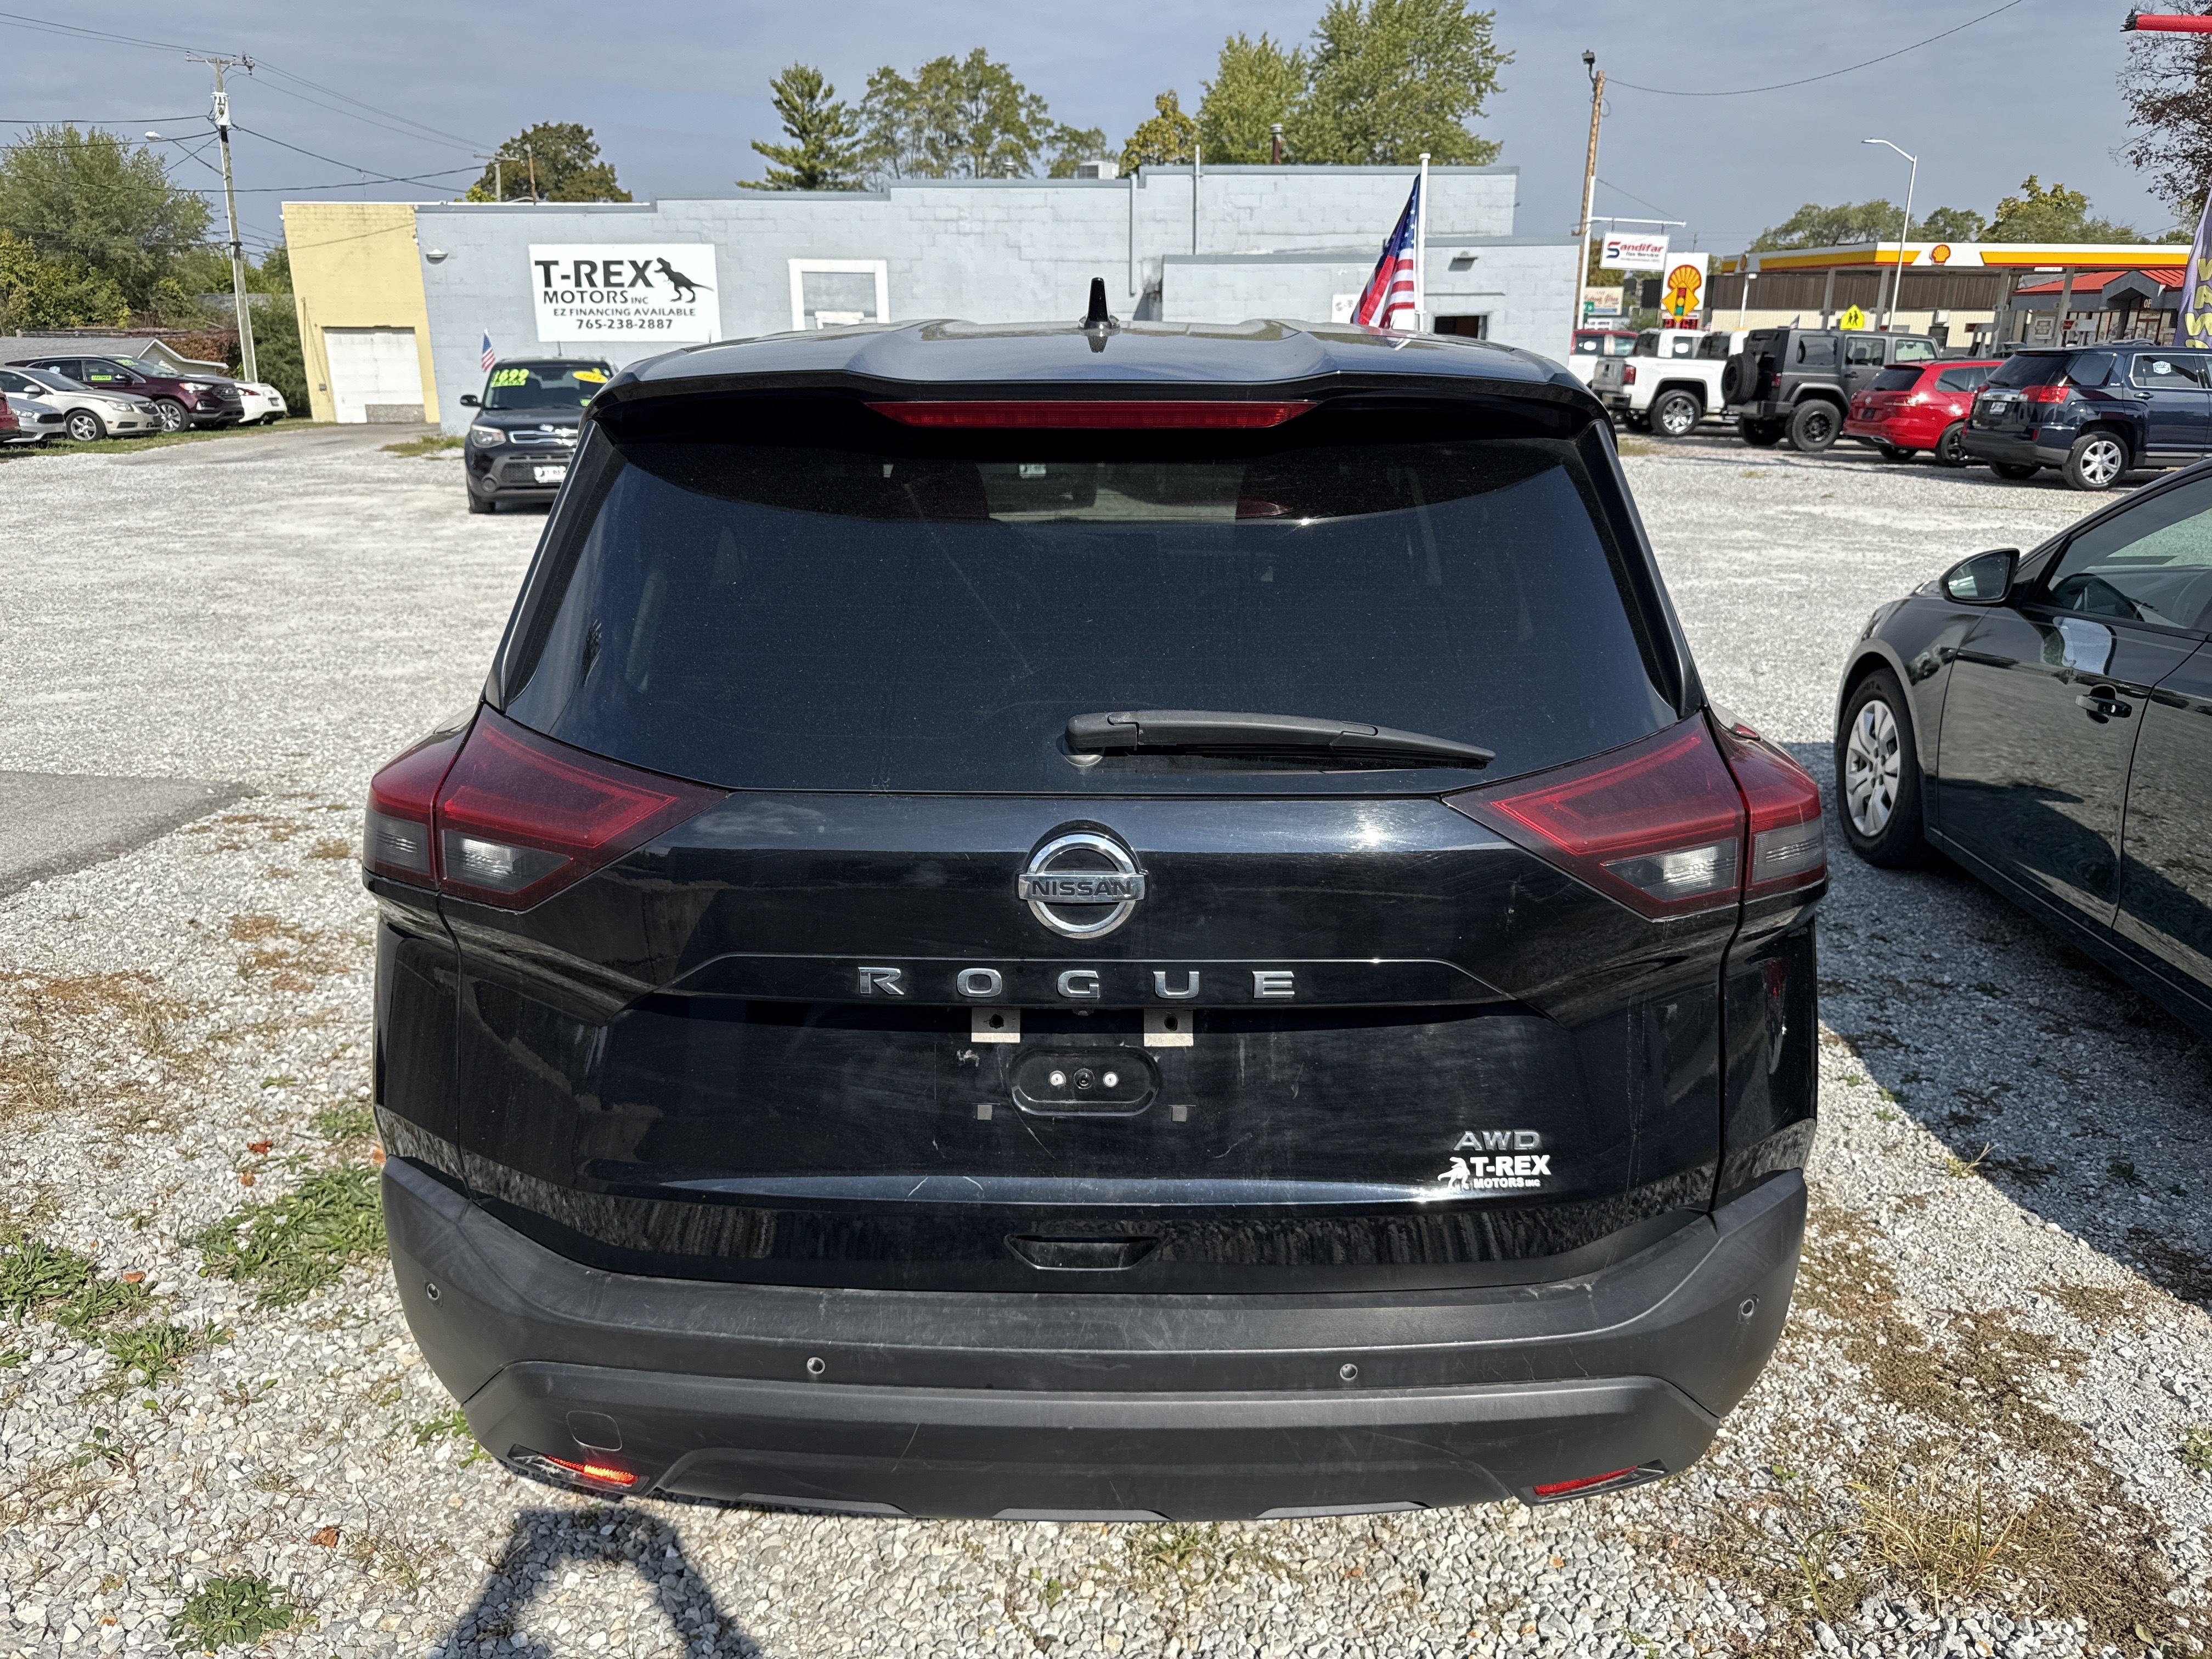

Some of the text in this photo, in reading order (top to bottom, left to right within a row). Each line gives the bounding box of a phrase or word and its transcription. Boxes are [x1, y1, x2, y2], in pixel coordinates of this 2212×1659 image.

[535, 260, 654, 288] T-REX
[544, 290, 628, 304] MOTORS
[554, 308, 696, 317] EZ FINANCING AVAILABLE
[575, 319, 673, 329] 765-238-2887
[1031, 880, 1131, 896] NISSAN
[857, 967, 1295, 999] ROGUE
[1453, 1131, 1541, 1151] AWD
[1470, 1154, 1552, 1177] T-REX
[1473, 1177, 1541, 1188] MOTORS INC
